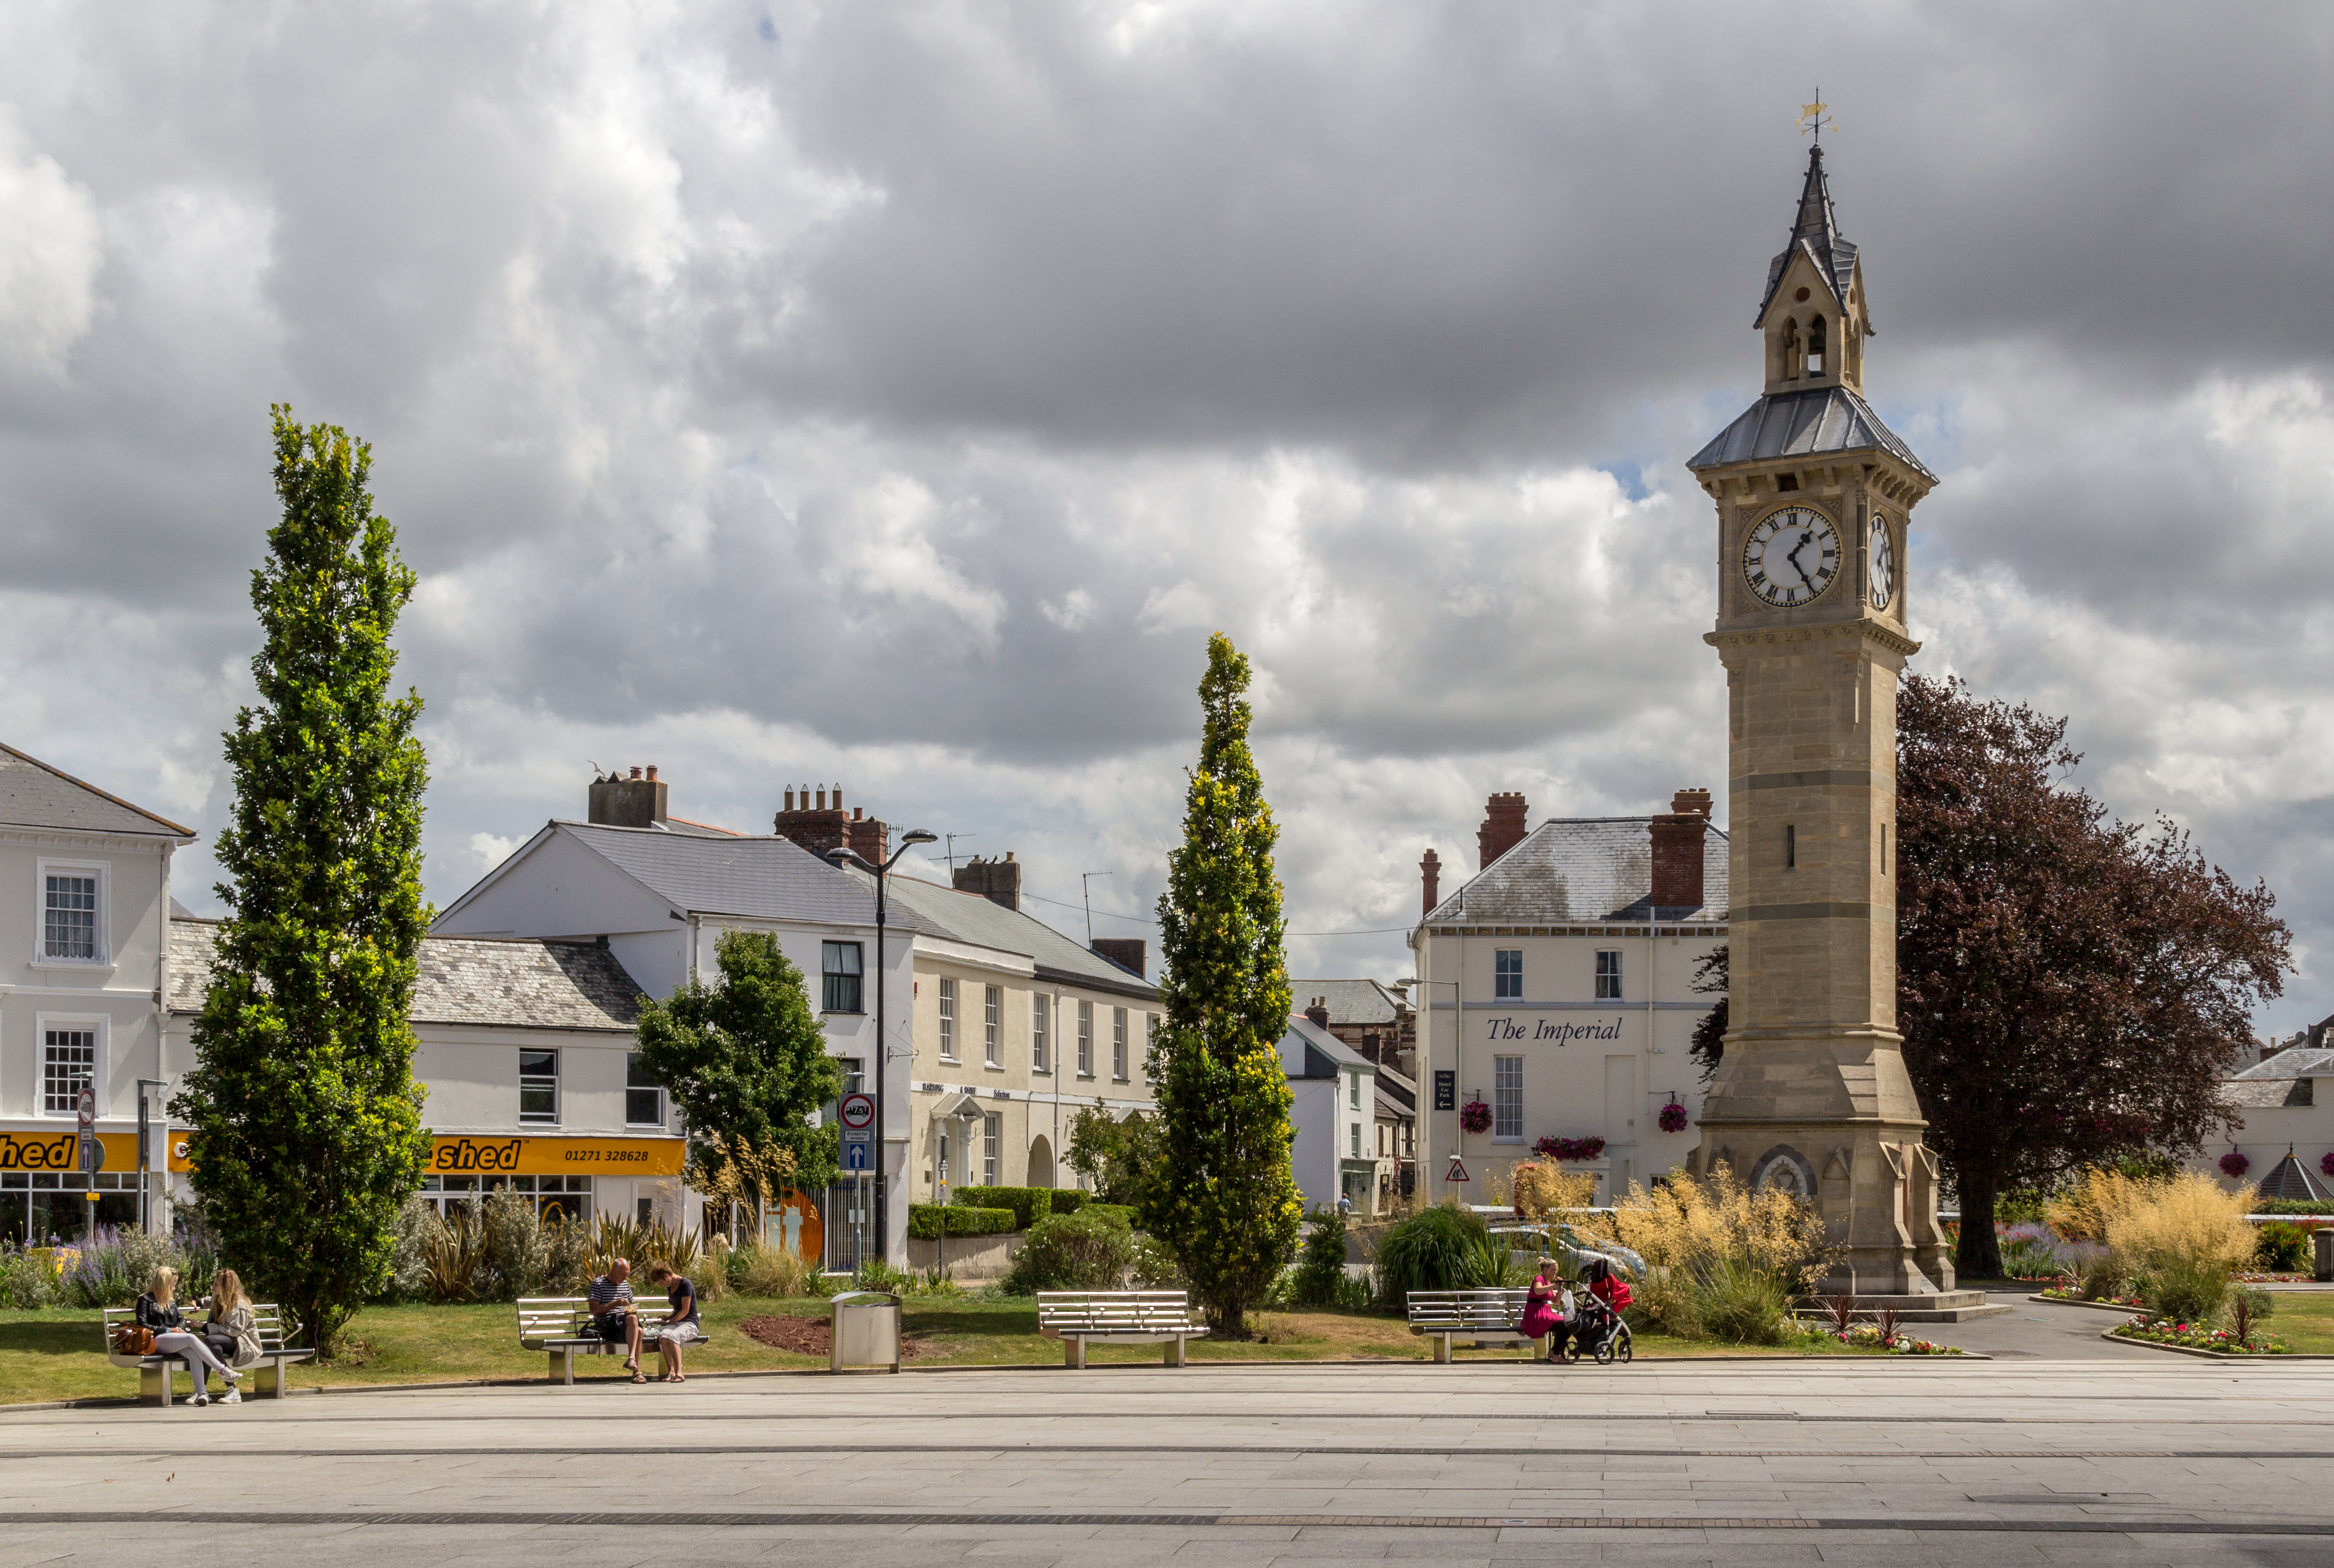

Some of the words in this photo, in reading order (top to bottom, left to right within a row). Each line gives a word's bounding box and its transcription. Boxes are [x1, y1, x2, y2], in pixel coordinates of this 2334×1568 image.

[1767, 518, 1780, 533] XI
[1787, 513, 1797, 526] XII
[1753, 536, 1766, 546] X
[1818, 530, 1830, 540] II
[1749, 556, 1761, 565] IX
[1787, 589, 1795, 602] VI
[1487, 1018, 1526, 1039] The
[1533, 1017, 1622, 1046] Imperial
[436, 1139, 521, 1170] shed
[565, 1151, 600, 1161] 01271
[605, 1151, 648, 1161] 328628
